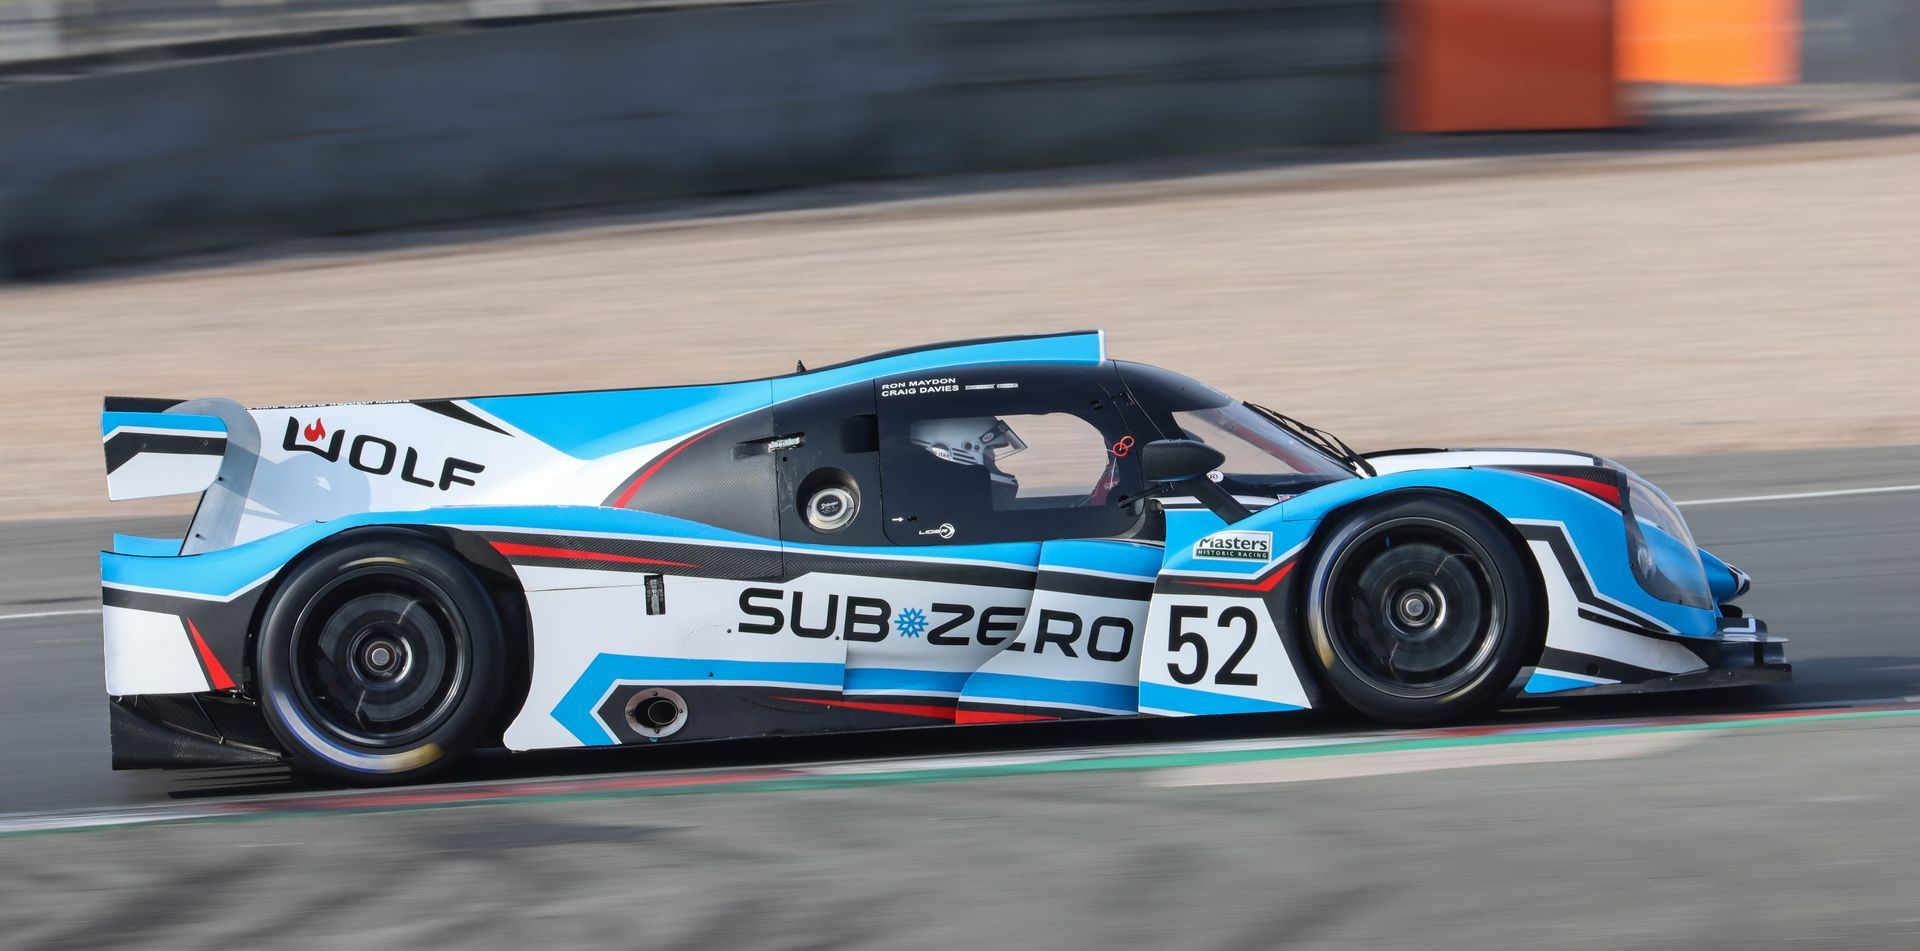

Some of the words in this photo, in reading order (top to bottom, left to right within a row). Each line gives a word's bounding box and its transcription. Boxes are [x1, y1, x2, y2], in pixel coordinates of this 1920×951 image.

[882, 382, 906, 390] RON
[909, 378, 956, 387] MAYDON
[881, 388, 916, 397] CRAIG
[919, 385, 959, 394] DAVIES
[282, 416, 486, 491] WOLF
[1198, 537, 1268, 550] Masters
[1237, 551, 1268, 559] RACING
[1167, 605, 1258, 686] 52
